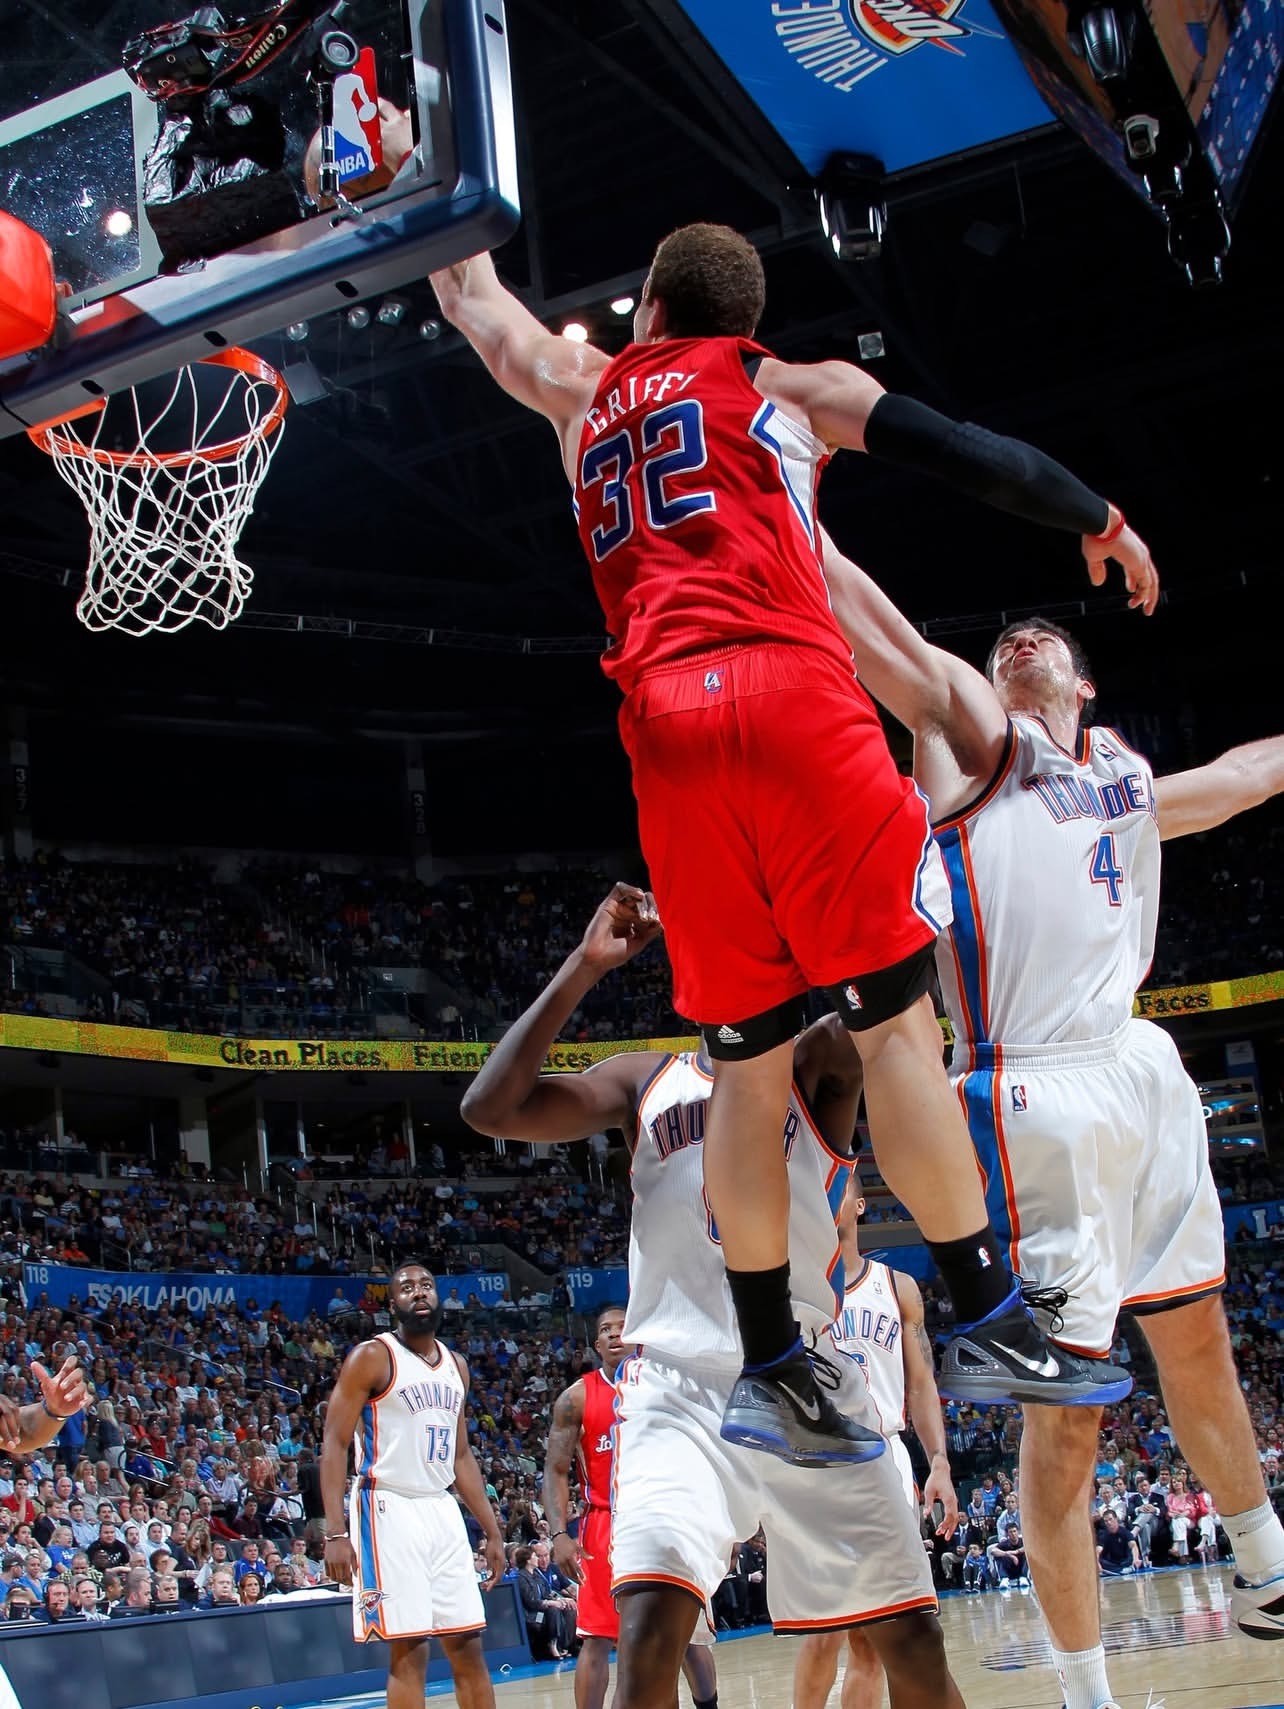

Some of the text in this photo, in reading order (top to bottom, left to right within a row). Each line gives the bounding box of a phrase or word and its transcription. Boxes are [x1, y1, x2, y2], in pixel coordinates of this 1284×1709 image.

[245, 24, 288, 69] Canon
[771, 0, 889, 92] THUNDE
[335, 152, 366, 176] NBA
[582, 399, 717, 562] 32
[1089, 832, 1123, 906] 4
[1137, 993, 1210, 1015] Faces
[220, 1039, 292, 1065] Clean
[297, 1042, 390, 1070] Places,
[650, 1100, 801, 1162] THUR
[26, 1266, 49, 1285] 118
[478, 1276, 505, 1292] 118
[567, 1273, 593, 1289] 119
[830, 1306, 900, 1355] UNDER
[396, 1382, 464, 1416] THUNDE
[425, 1424, 452, 1463] 13
[595, 1434, 612, 1453] Lo
